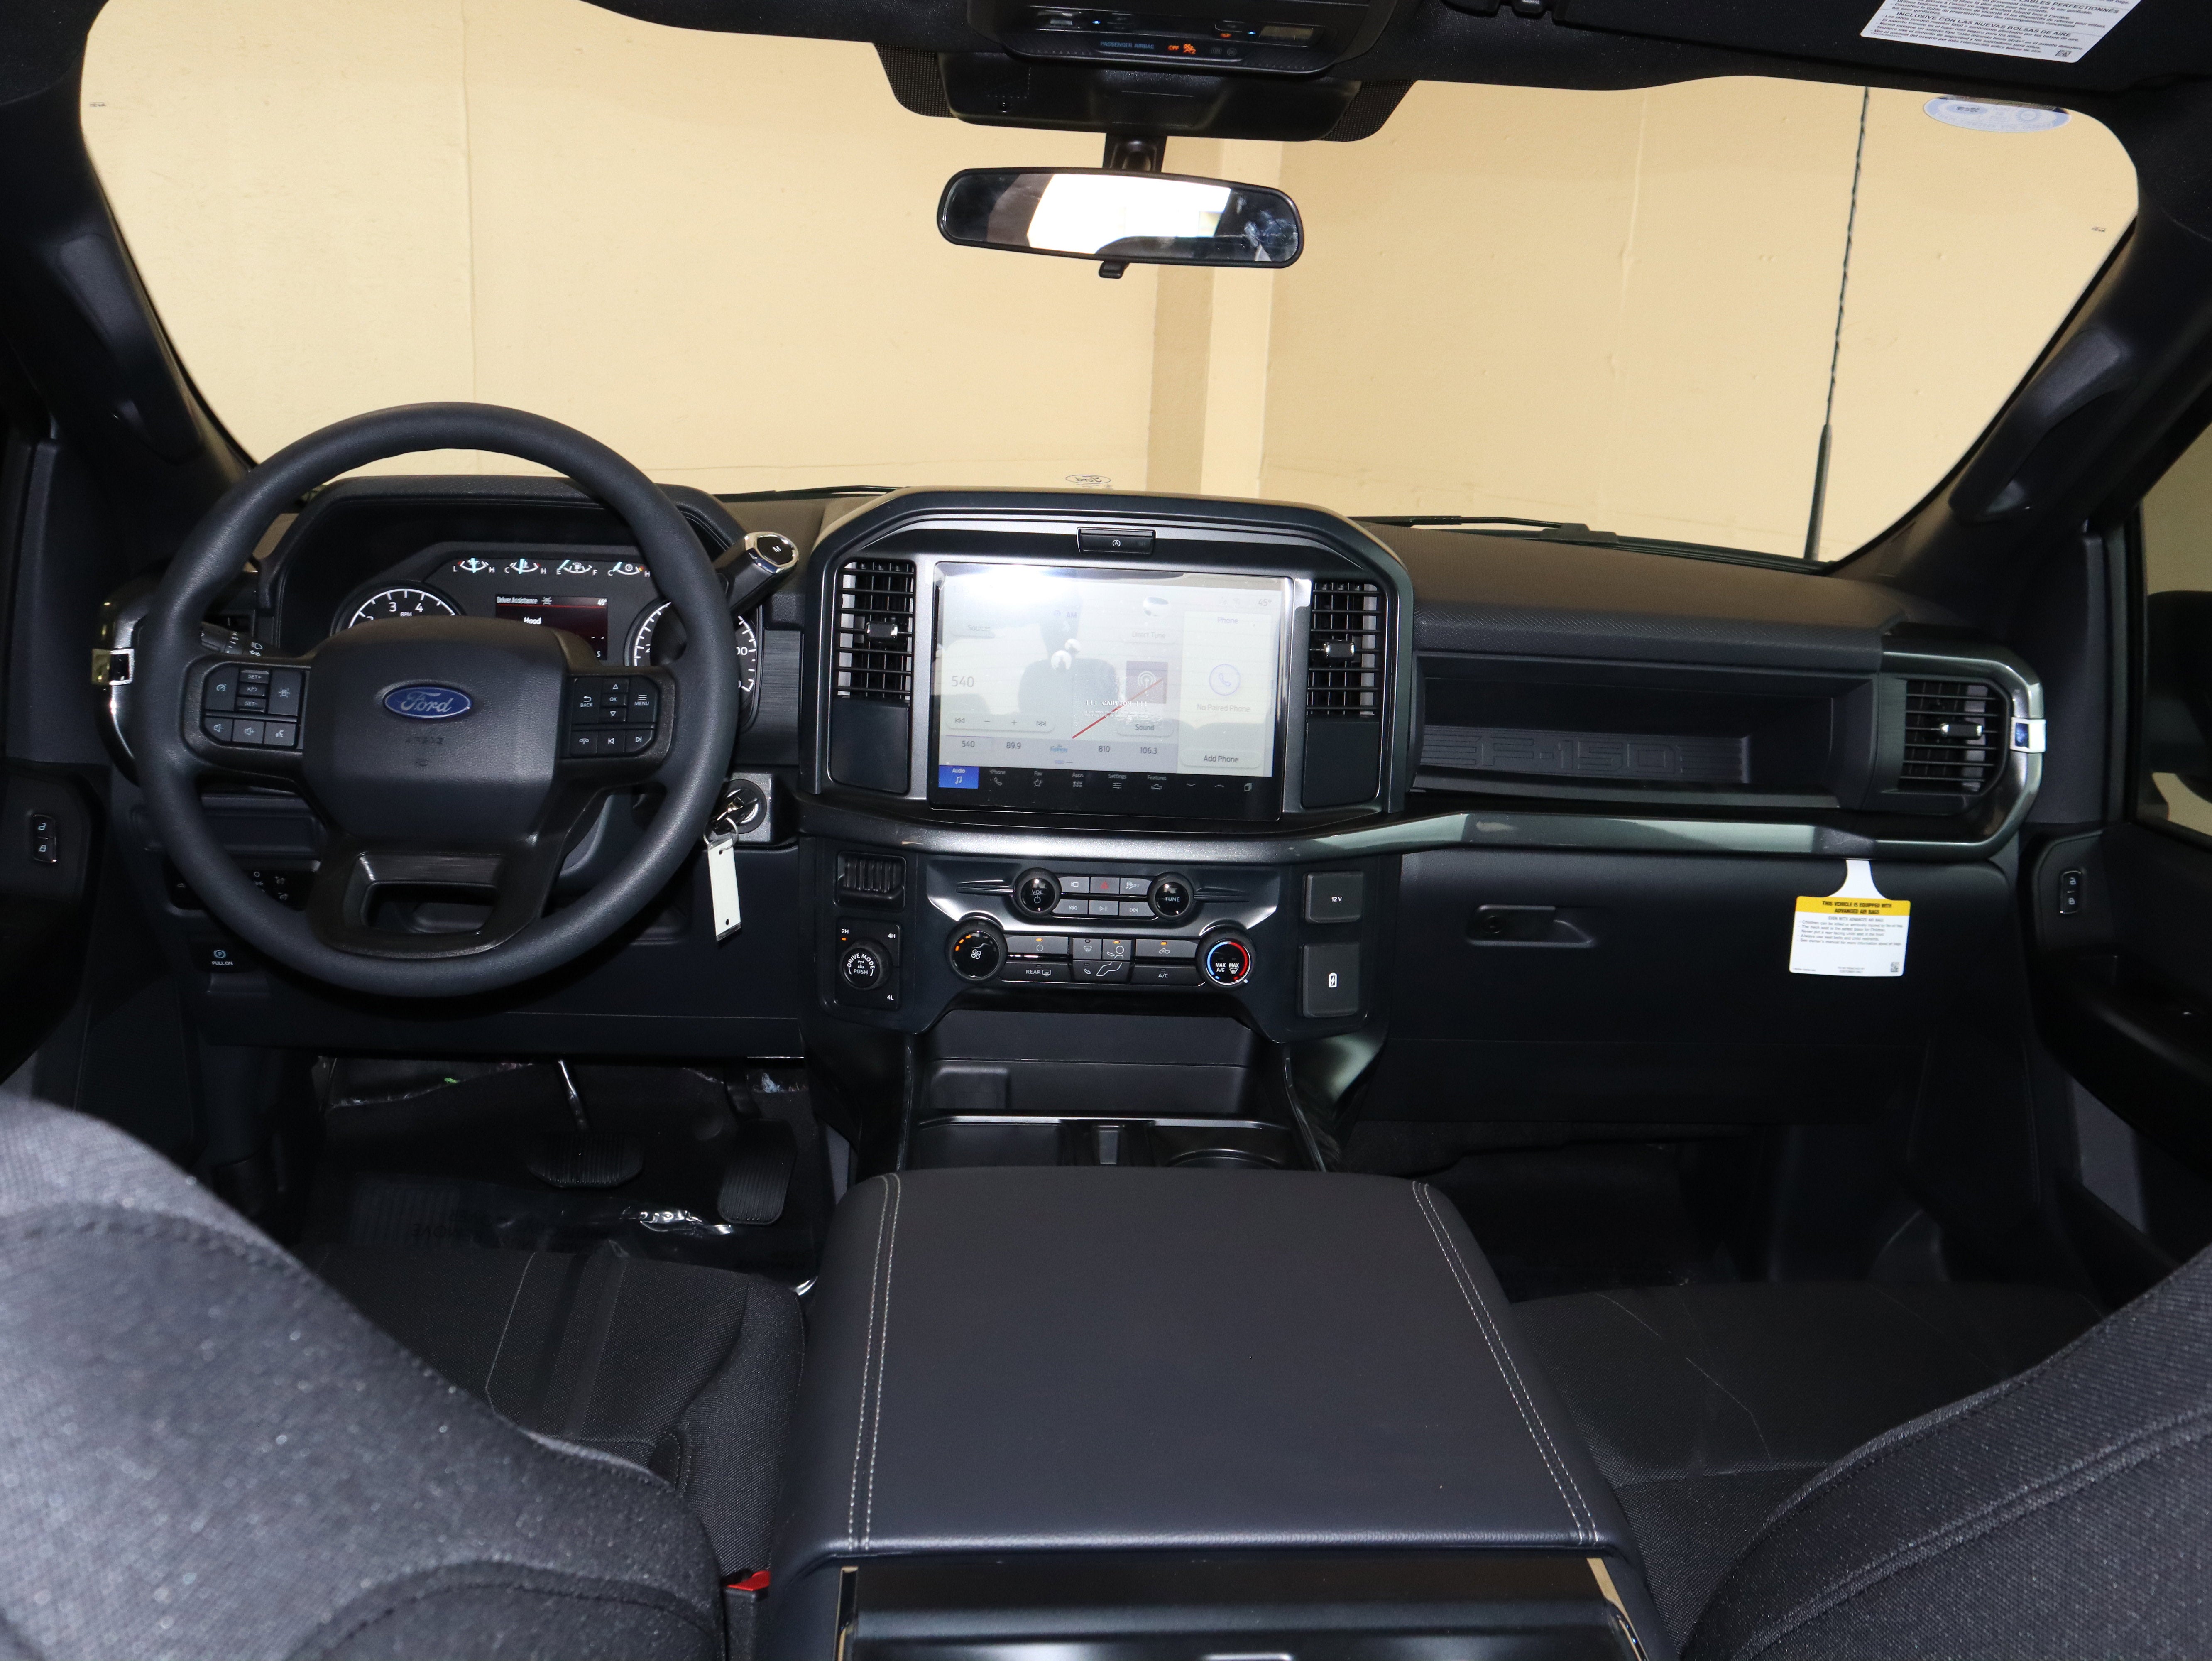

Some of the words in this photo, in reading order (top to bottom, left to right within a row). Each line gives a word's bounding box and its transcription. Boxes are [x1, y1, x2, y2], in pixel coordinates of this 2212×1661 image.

[2053, 2, 2119, 13] PERFECTIONNÉS
[1896, 12, 1937, 20] INCLUSIVE
[389, 602, 397, 612] 3
[415, 603, 423, 613] 4
[1217, 616, 1239, 625] Phone
[951, 676, 974, 688] 540
[401, 691, 454, 713] Ford
[1210, 703, 1228, 712] Paired
[1229, 704, 1250, 713] Phone
[1204, 754, 1216, 762] Add
[1218, 755, 1238, 763] Phone
[1480, 737, 1677, 773] F-150
[847, 953, 860, 968] DRIVE
[861, 953, 875, 969] MODE
